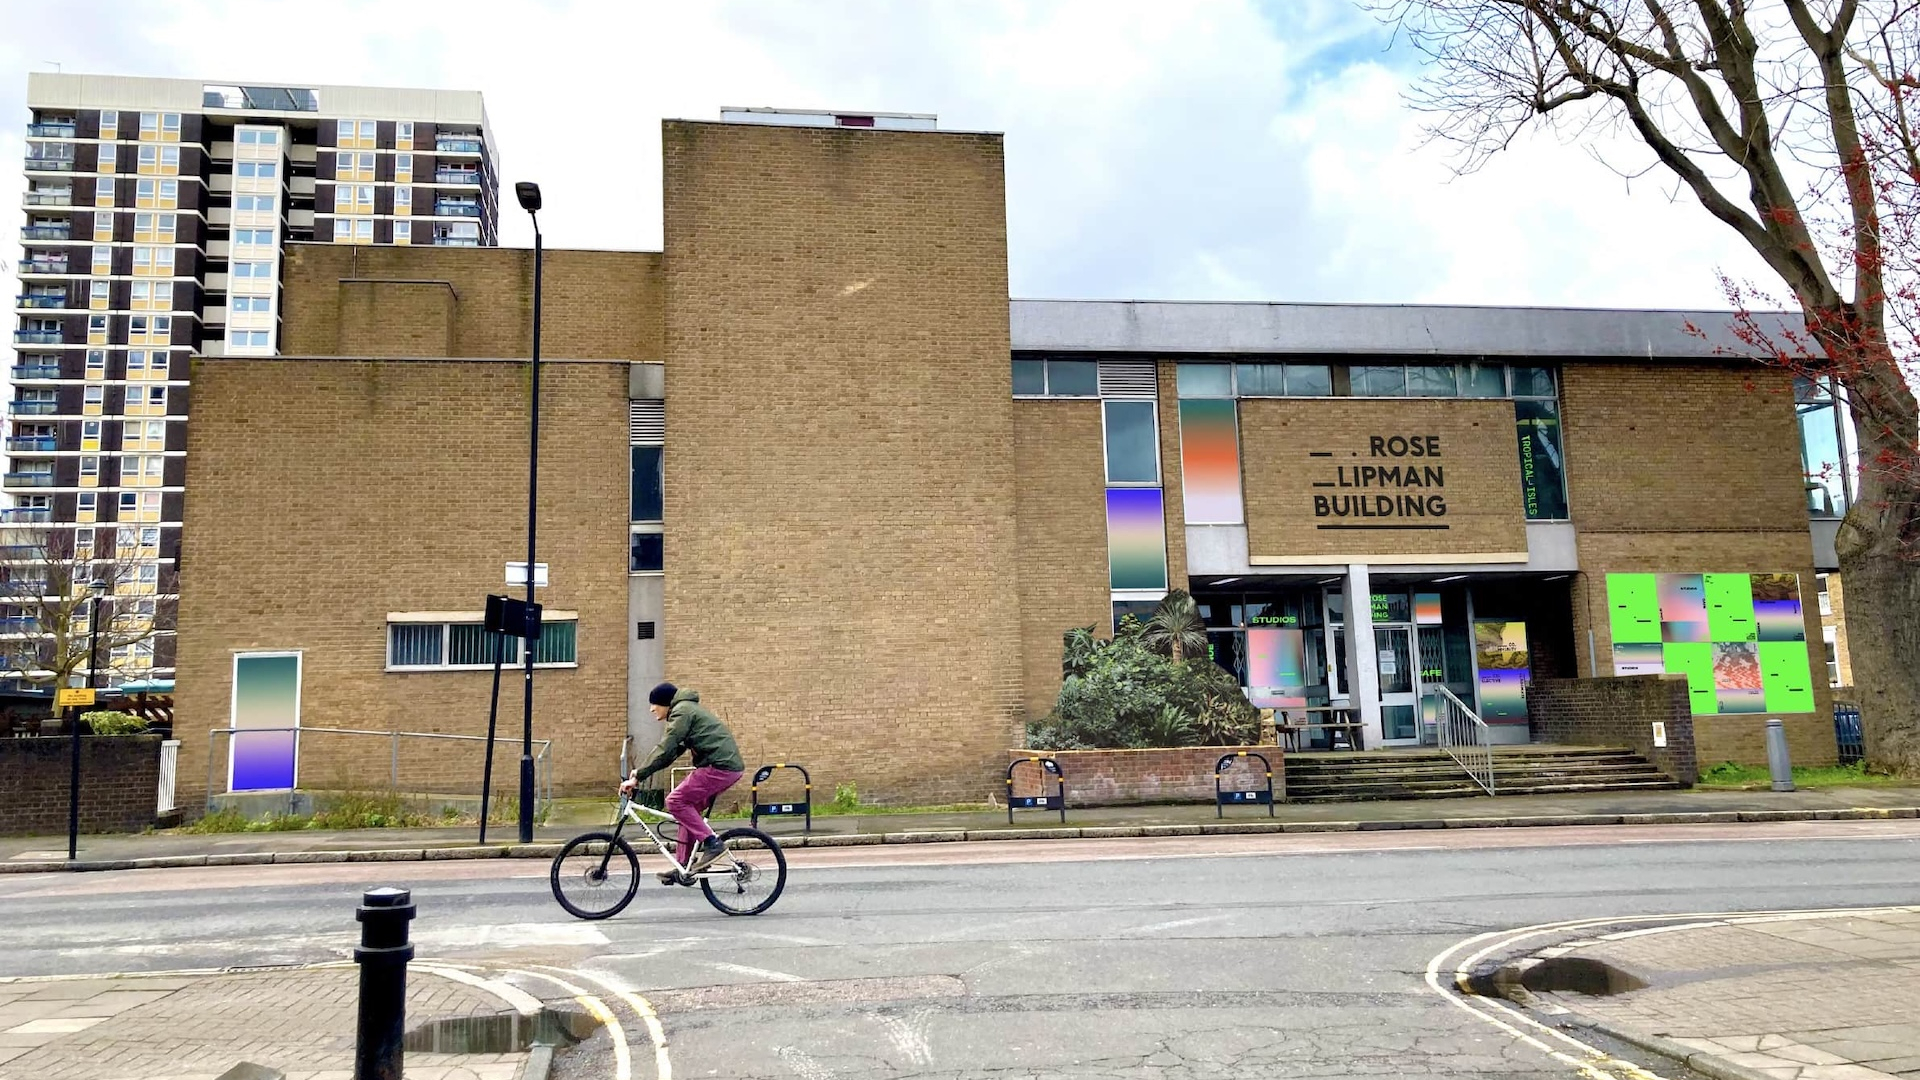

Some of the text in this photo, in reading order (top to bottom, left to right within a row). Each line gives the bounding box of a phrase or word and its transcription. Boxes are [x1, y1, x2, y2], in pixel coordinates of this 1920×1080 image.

[1370, 436, 1441, 457] ROSE
[1337, 465, 1444, 488] LIPMAN
[1521, 434, 1538, 516] TROPICAL ISLES
[1315, 495, 1447, 518] BUILDING
[1252, 616, 1297, 624] STUDIOS
